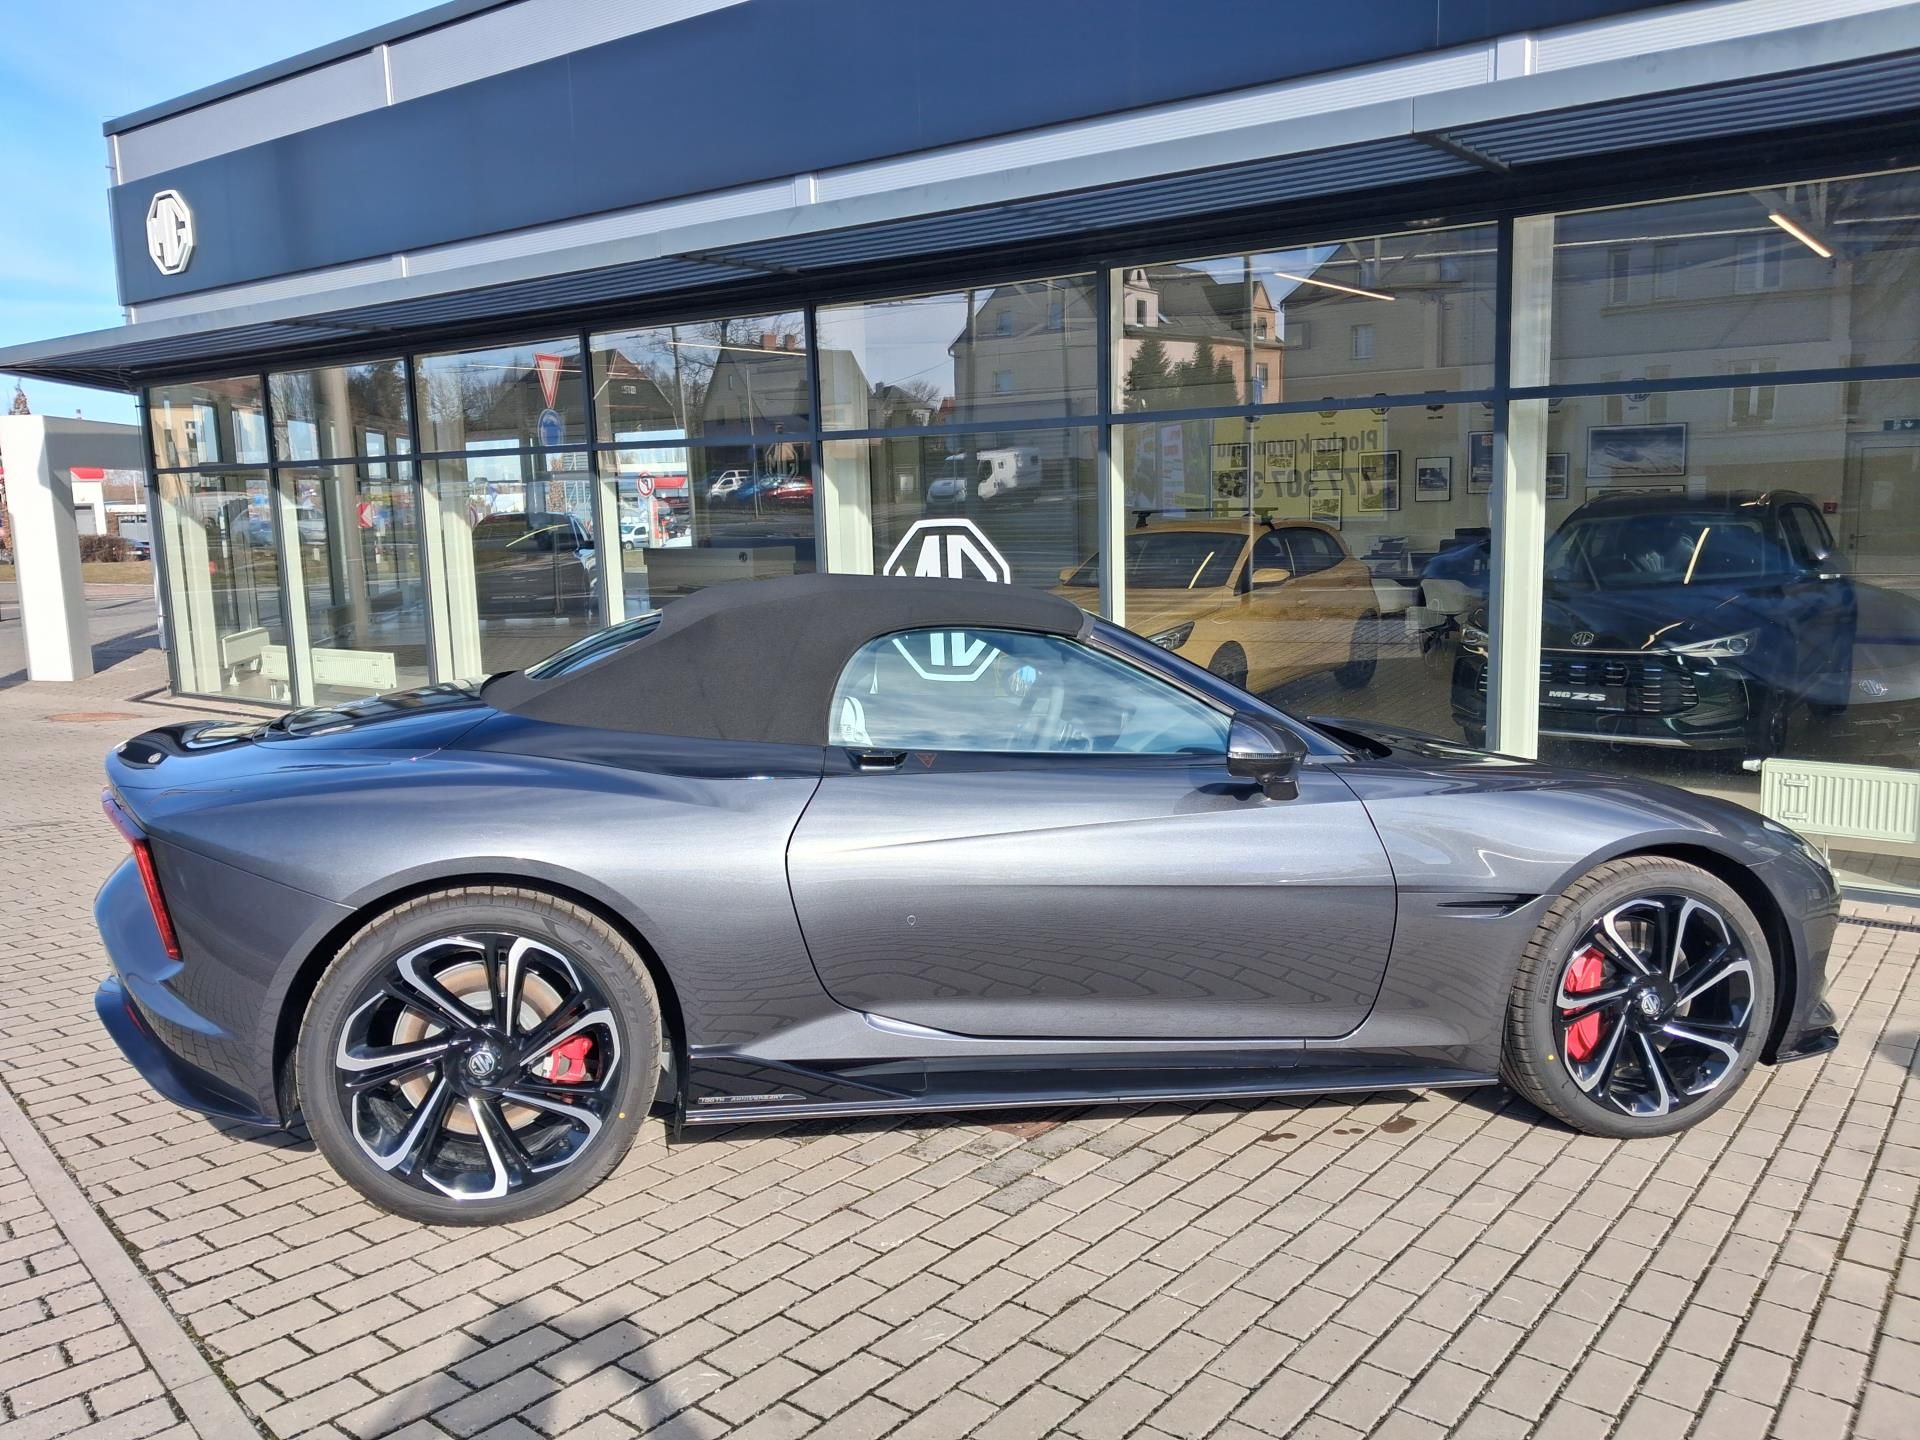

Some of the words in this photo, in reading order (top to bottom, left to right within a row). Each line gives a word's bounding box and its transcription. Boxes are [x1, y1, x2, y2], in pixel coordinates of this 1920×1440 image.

[147, 191, 192, 273] MG
[1570, 631, 1594, 646] MG
[1548, 690, 1571, 698] MG
[1571, 692, 1607, 701] ZS
